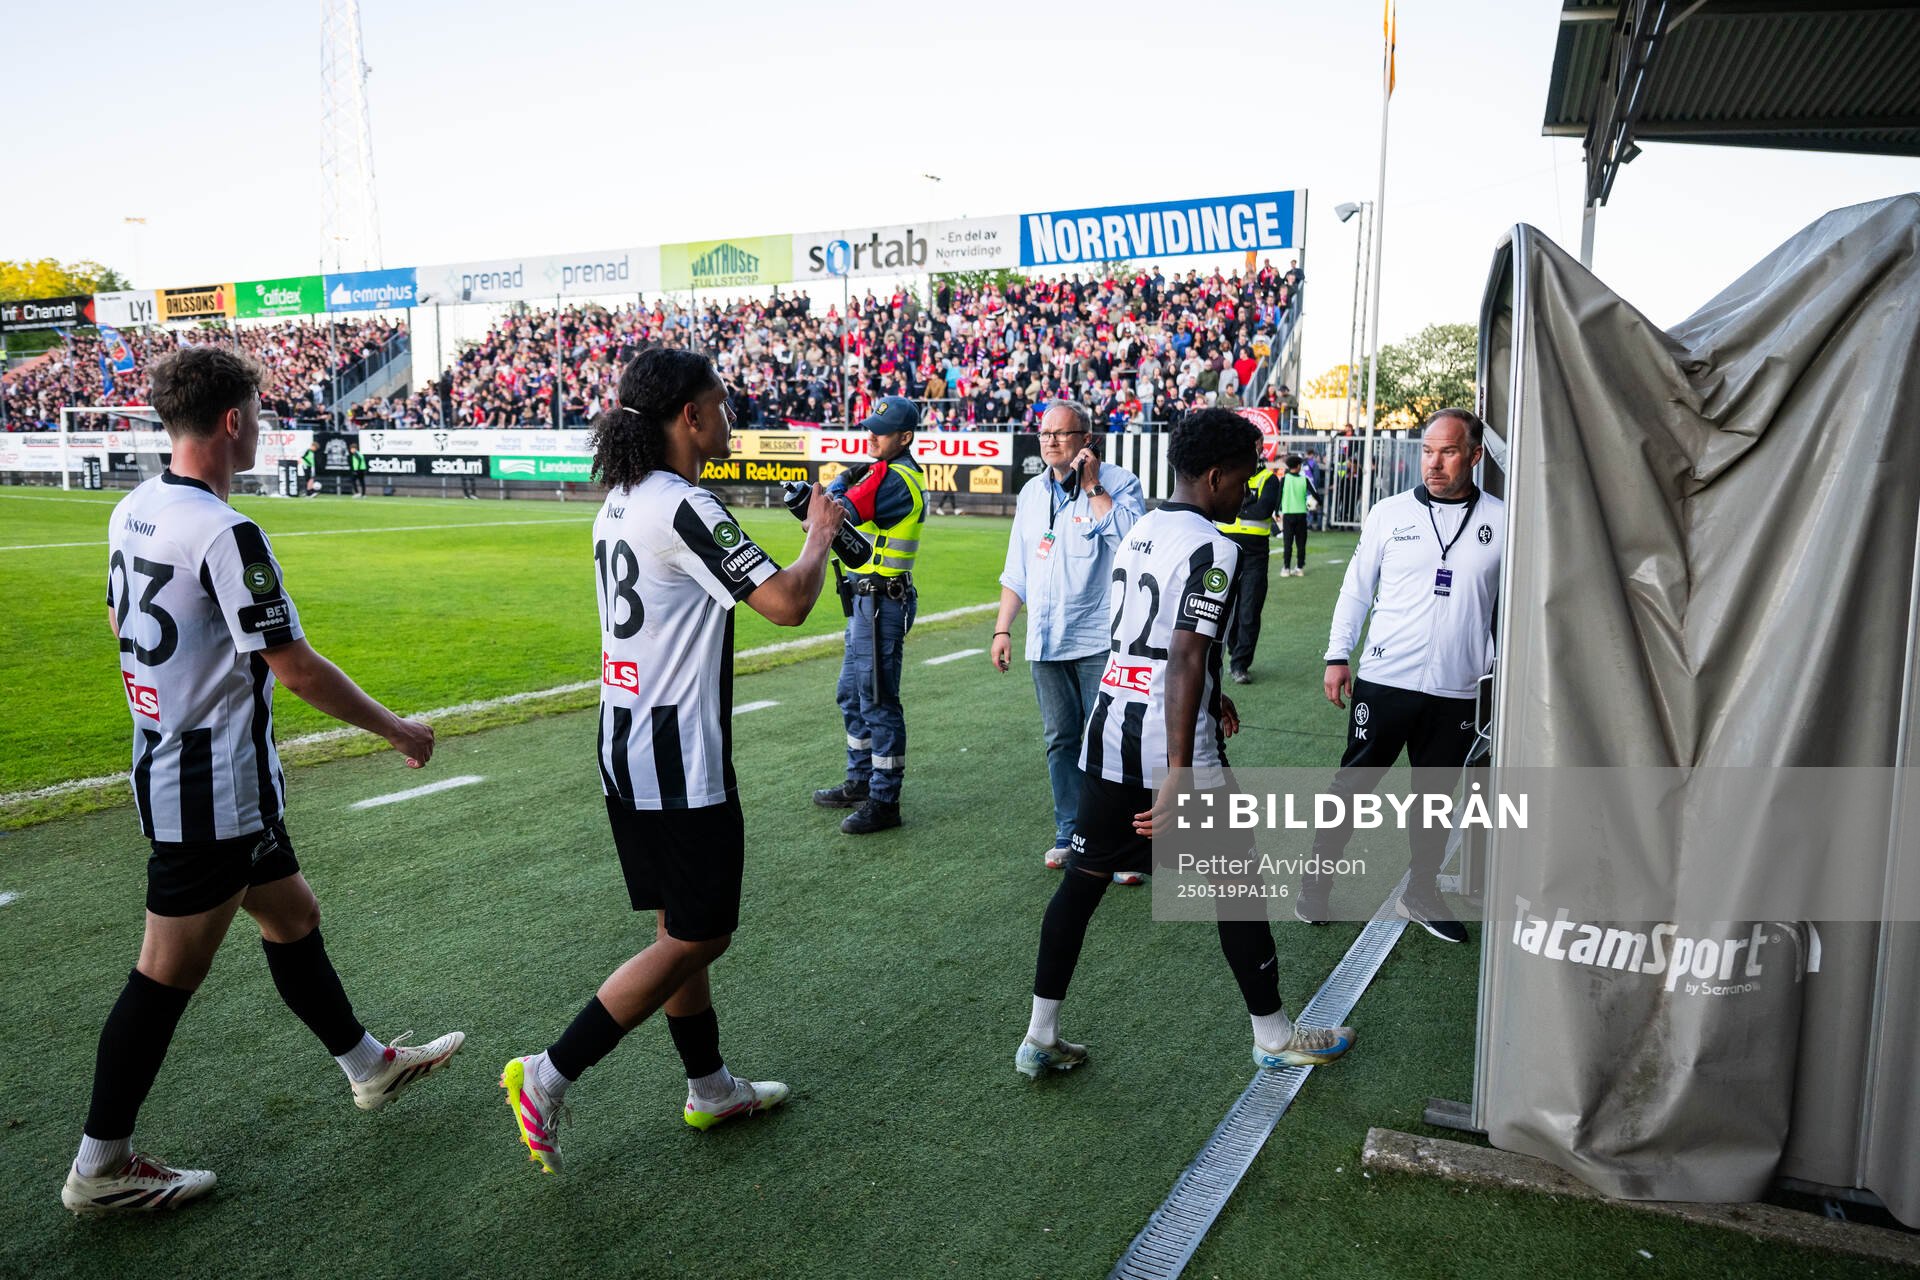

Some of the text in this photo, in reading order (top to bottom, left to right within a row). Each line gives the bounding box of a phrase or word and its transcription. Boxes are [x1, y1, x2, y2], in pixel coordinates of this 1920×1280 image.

[948, 231, 962, 243] En
[964, 230, 981, 242] del
[984, 230, 997, 240] av
[1028, 202, 1281, 263] NORRVIDINGE
[809, 229, 928, 277] sortab
[936, 246, 1002, 259] Norrvidinge
[463, 264, 523, 292] prenad
[563, 255, 629, 290] prenad
[166, 294, 215, 314] OHLSSONS
[759, 441, 797, 450] OHLSSONS
[918, 439, 1000, 457] PULS
[368, 457, 416, 474] stadium
[431, 457, 483, 475] stadium
[745, 462, 808, 482] Reklam
[973, 477, 999, 486] CHARK
[726, 545, 762, 572] UNIBET
[595, 539, 645, 640] 18
[110, 549, 179, 667] 23
[1111, 567, 1169, 661] 22
[1512, 894, 1768, 992] TatamSport
[1685, 981, 1700, 996] by
